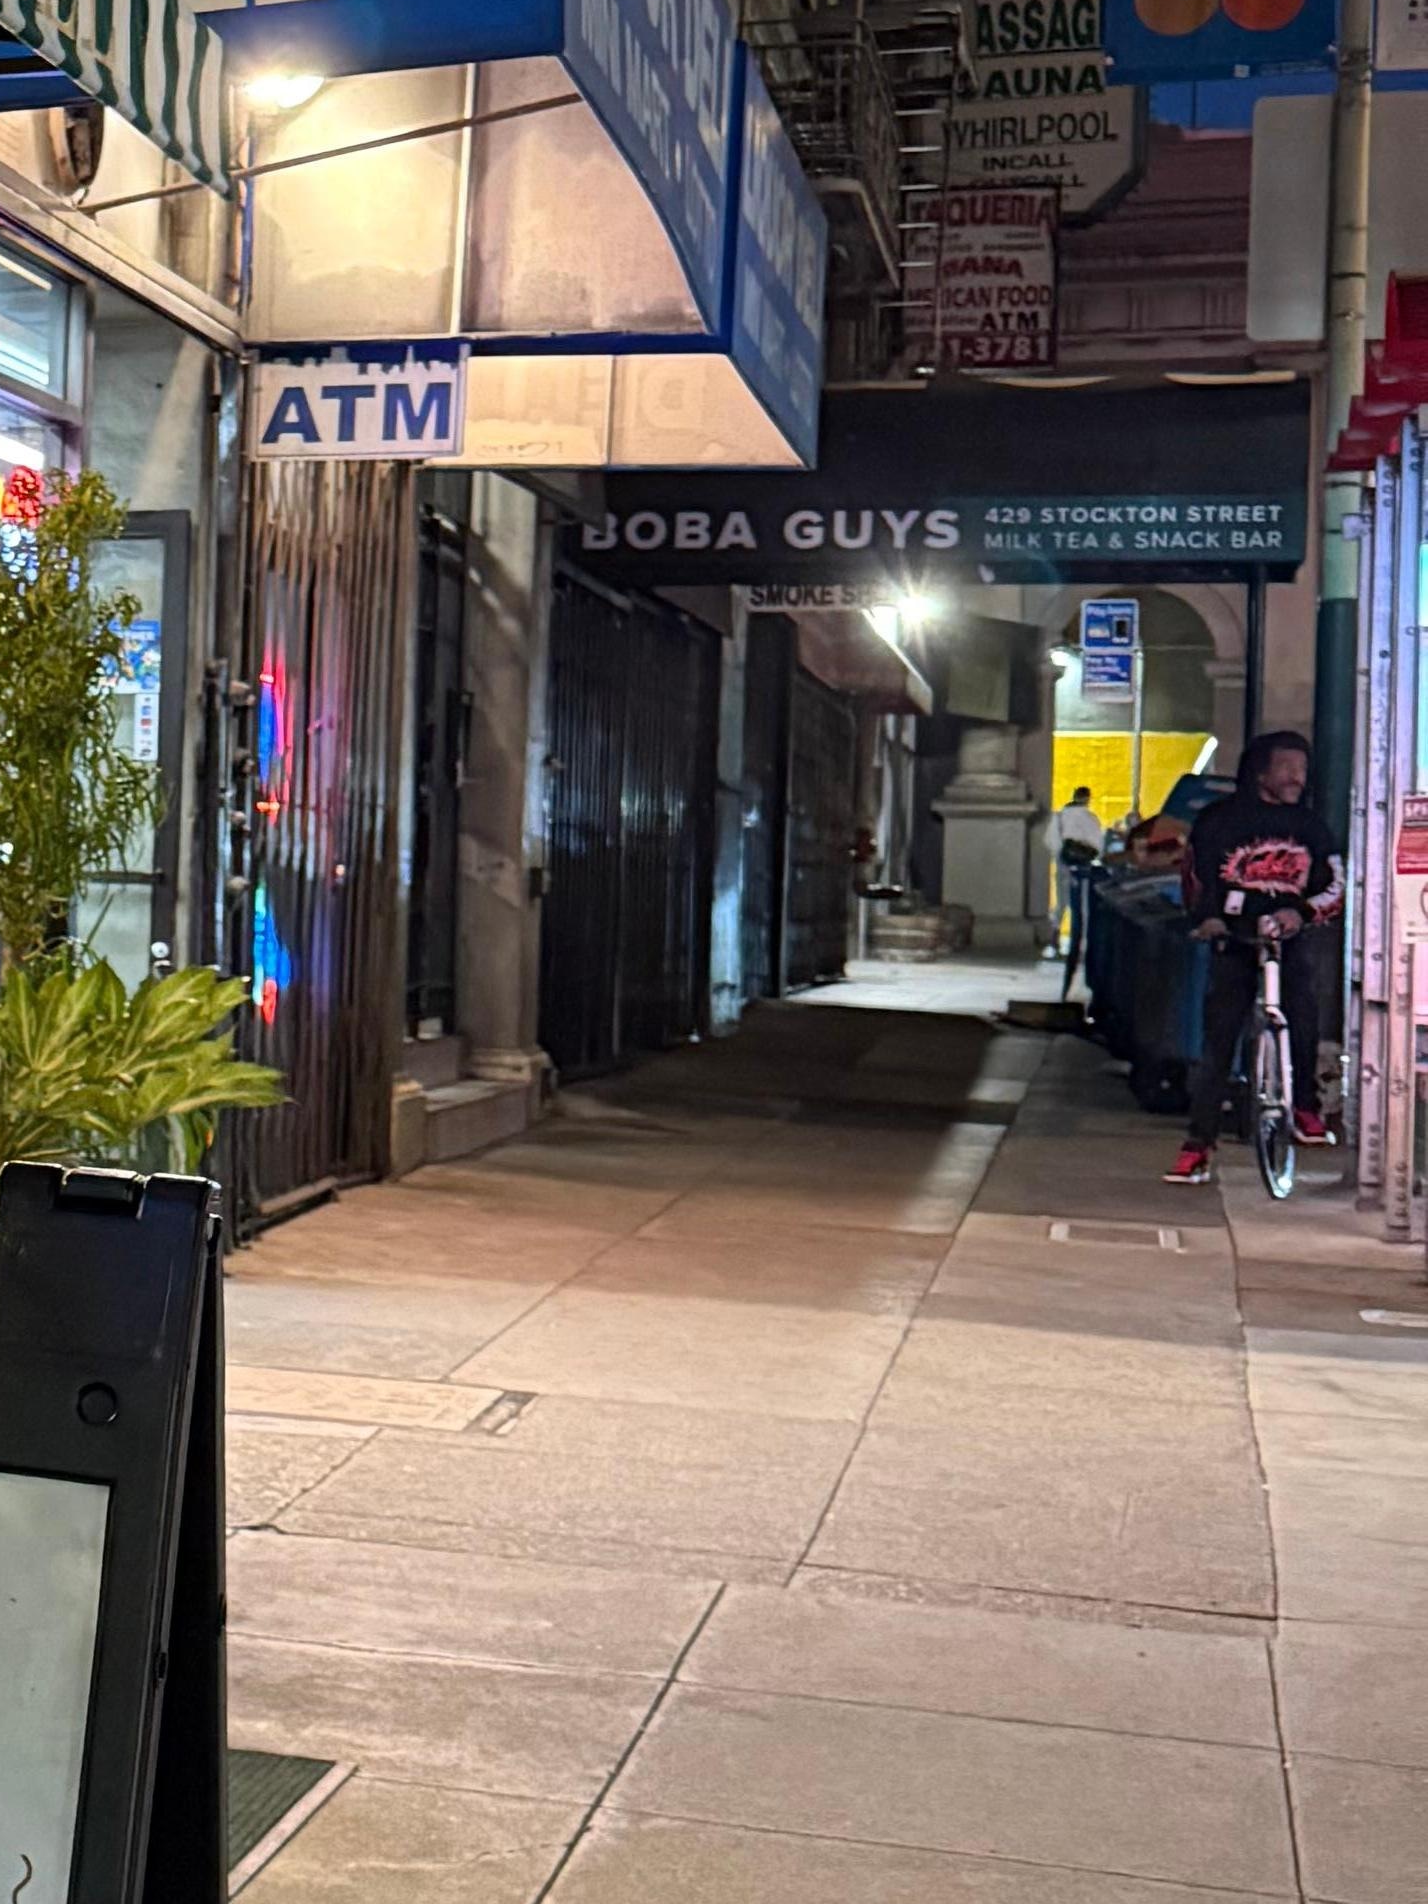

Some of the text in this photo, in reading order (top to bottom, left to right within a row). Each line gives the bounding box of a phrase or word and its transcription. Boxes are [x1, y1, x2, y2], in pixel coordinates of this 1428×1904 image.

[981, 311, 1039, 332] ATM
[261, 382, 452, 444] ATM
[984, 504, 1283, 524] 429 STOCKTON STREET
[583, 509, 961, 551] BOBA GUYS
[984, 530, 1283, 549] MILK TEA & SNACK BAR
